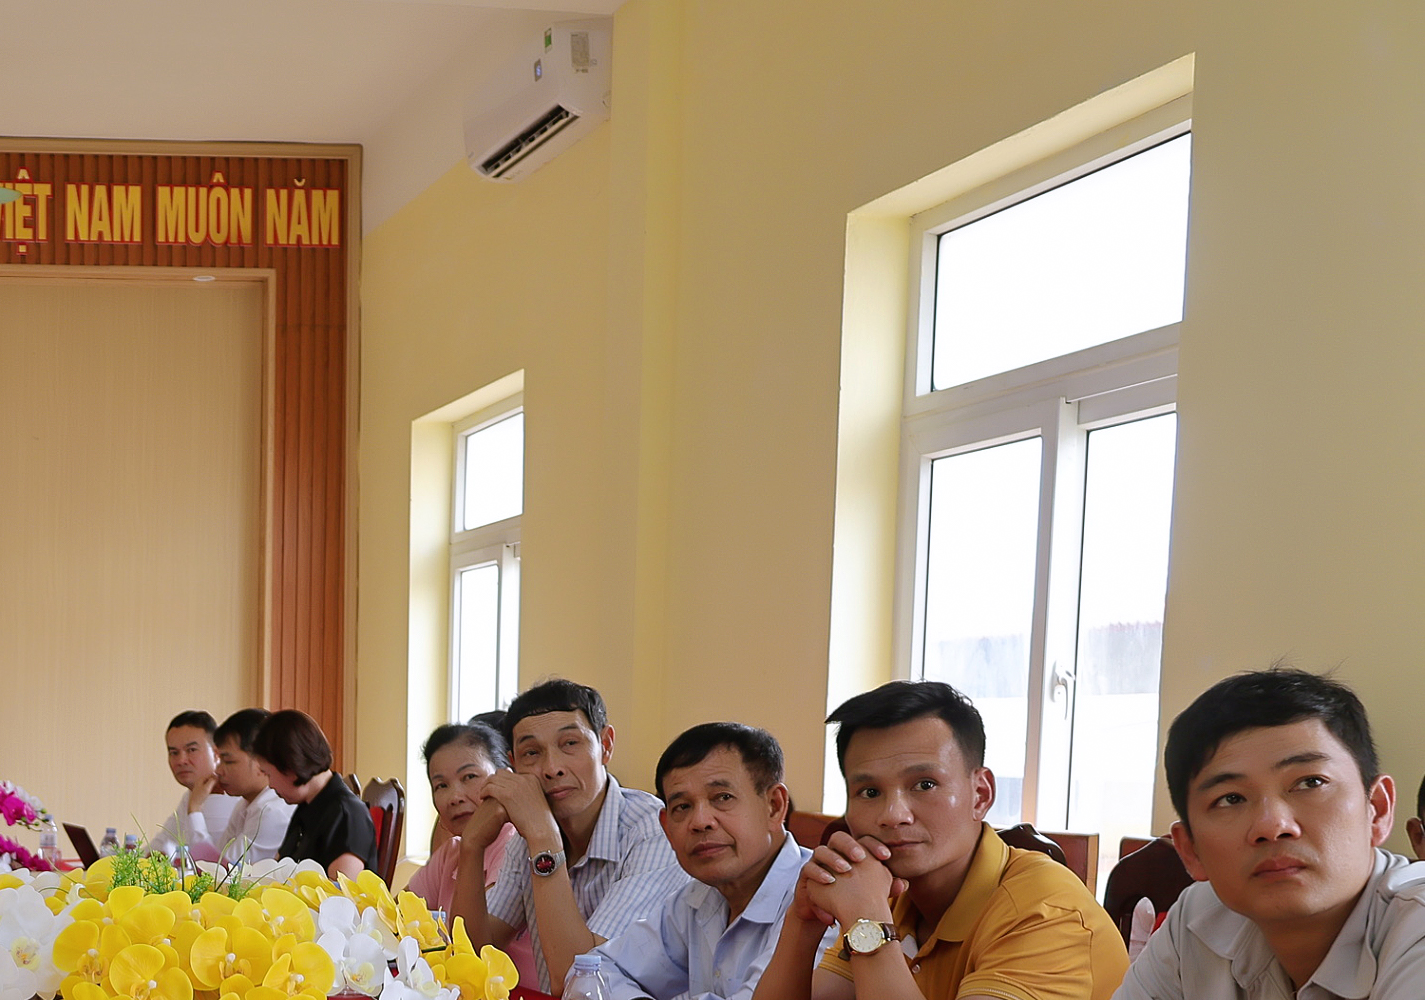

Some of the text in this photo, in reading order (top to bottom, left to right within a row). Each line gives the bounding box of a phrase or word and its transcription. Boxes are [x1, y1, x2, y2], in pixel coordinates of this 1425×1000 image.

[66, 184, 141, 242] NAM
[157, 172, 252, 244] MUÔN
[266, 179, 339, 245] NĂM
